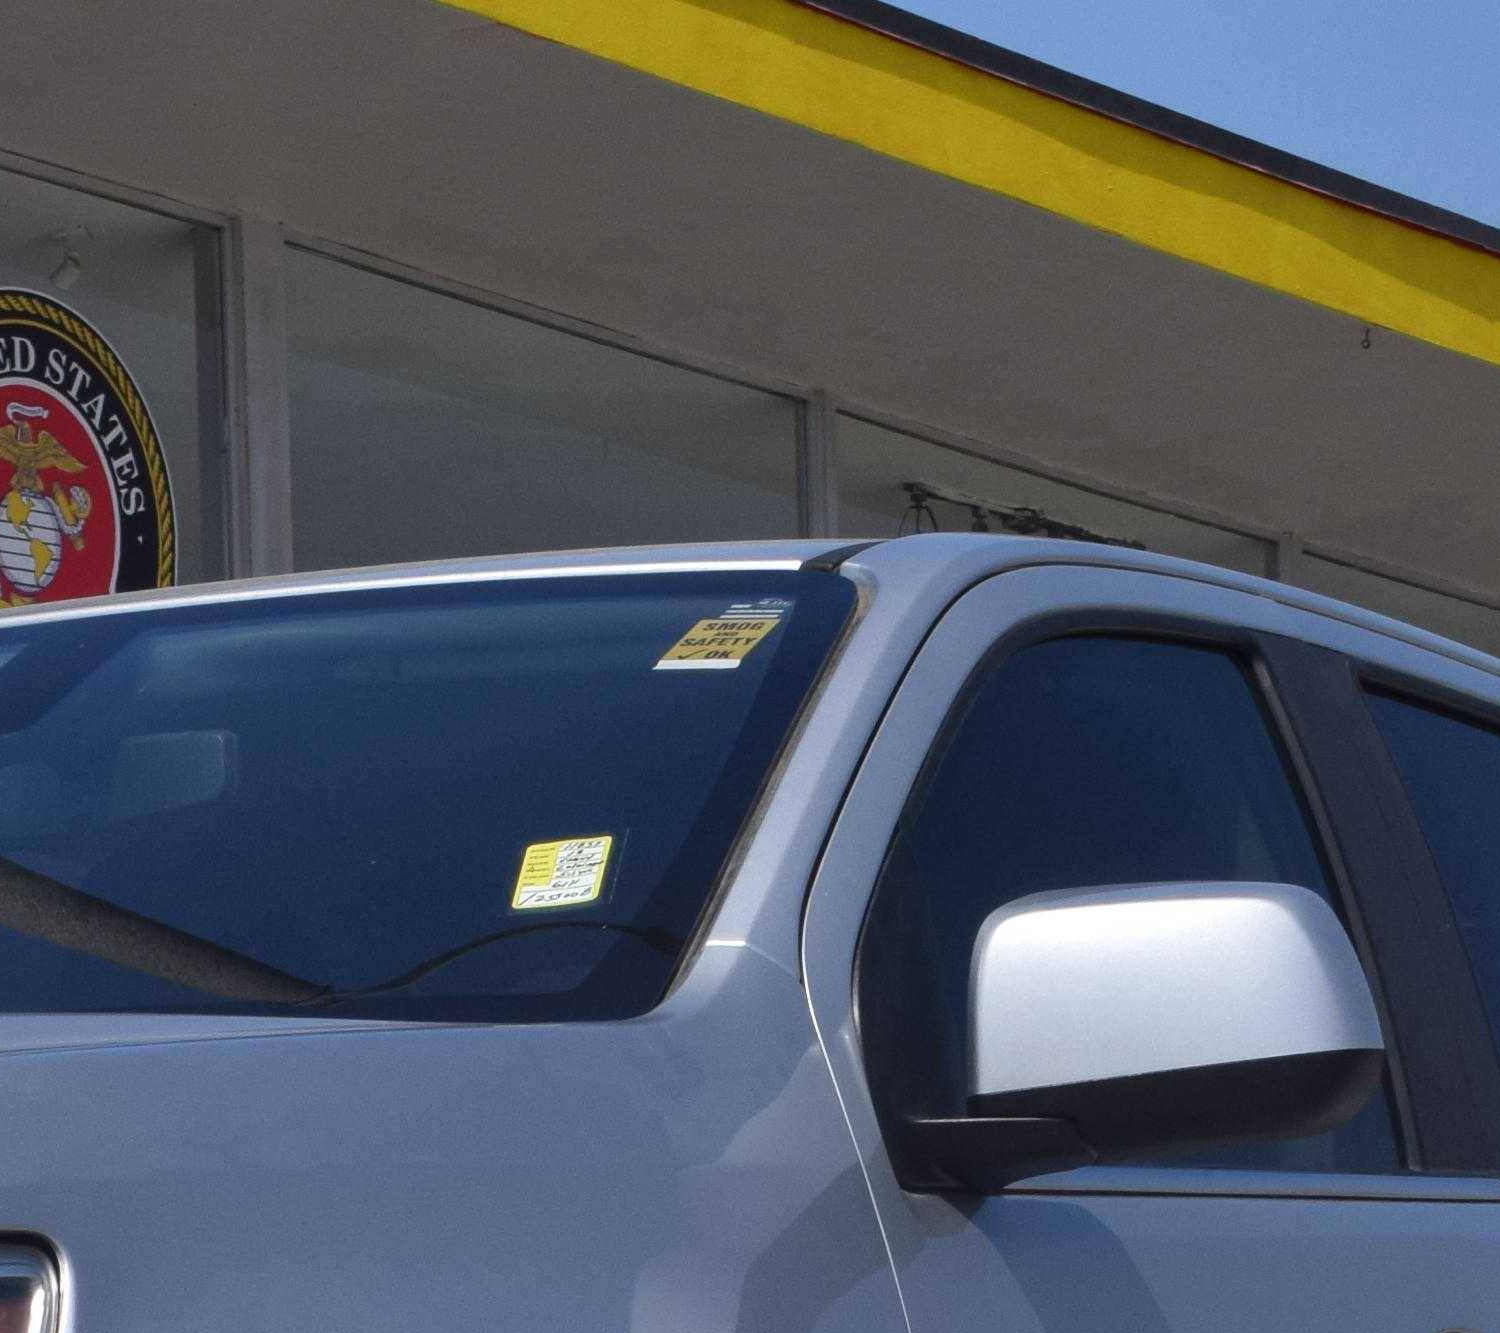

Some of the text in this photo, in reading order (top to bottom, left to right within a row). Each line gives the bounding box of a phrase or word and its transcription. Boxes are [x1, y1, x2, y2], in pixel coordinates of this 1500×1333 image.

[41, 347, 147, 518] STATES
[702, 621, 767, 632] SMOG
[679, 637, 759, 647] SAFETY
[703, 650, 735, 660] OK
